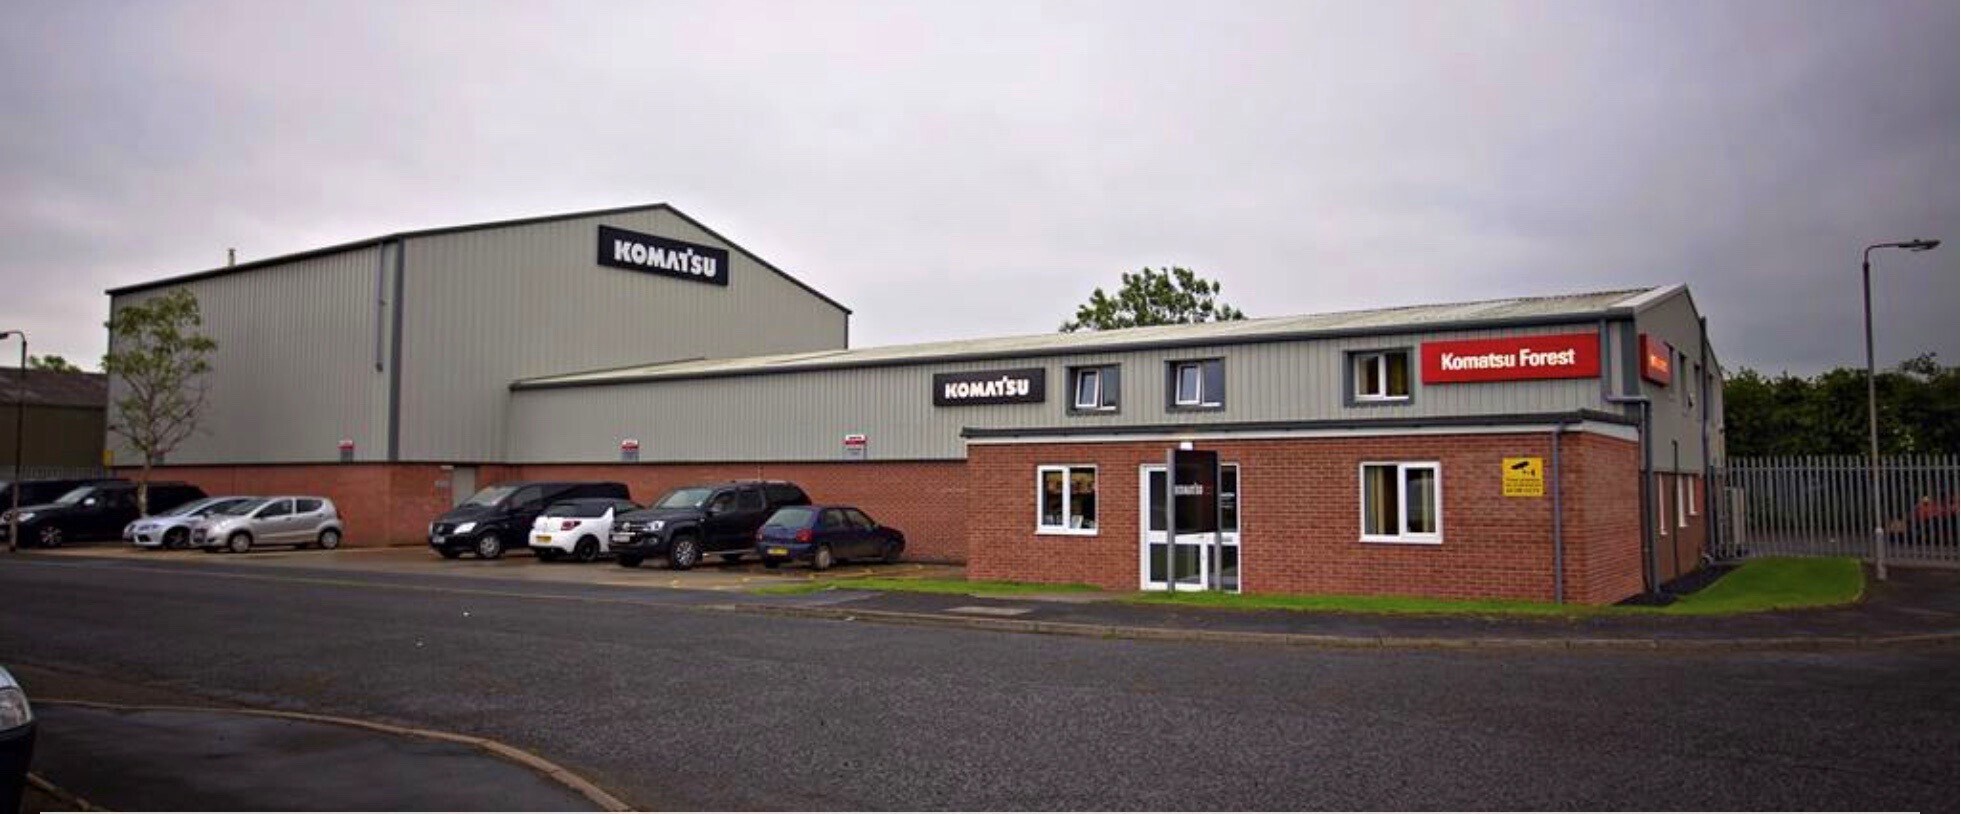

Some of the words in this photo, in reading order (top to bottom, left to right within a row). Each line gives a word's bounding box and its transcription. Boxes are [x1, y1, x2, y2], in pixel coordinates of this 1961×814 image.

[613, 239, 717, 277] KOMATSU
[1441, 352, 1516, 370] Komatsu
[1519, 348, 1575, 367] Forest
[945, 375, 1030, 399] KOMATSU
